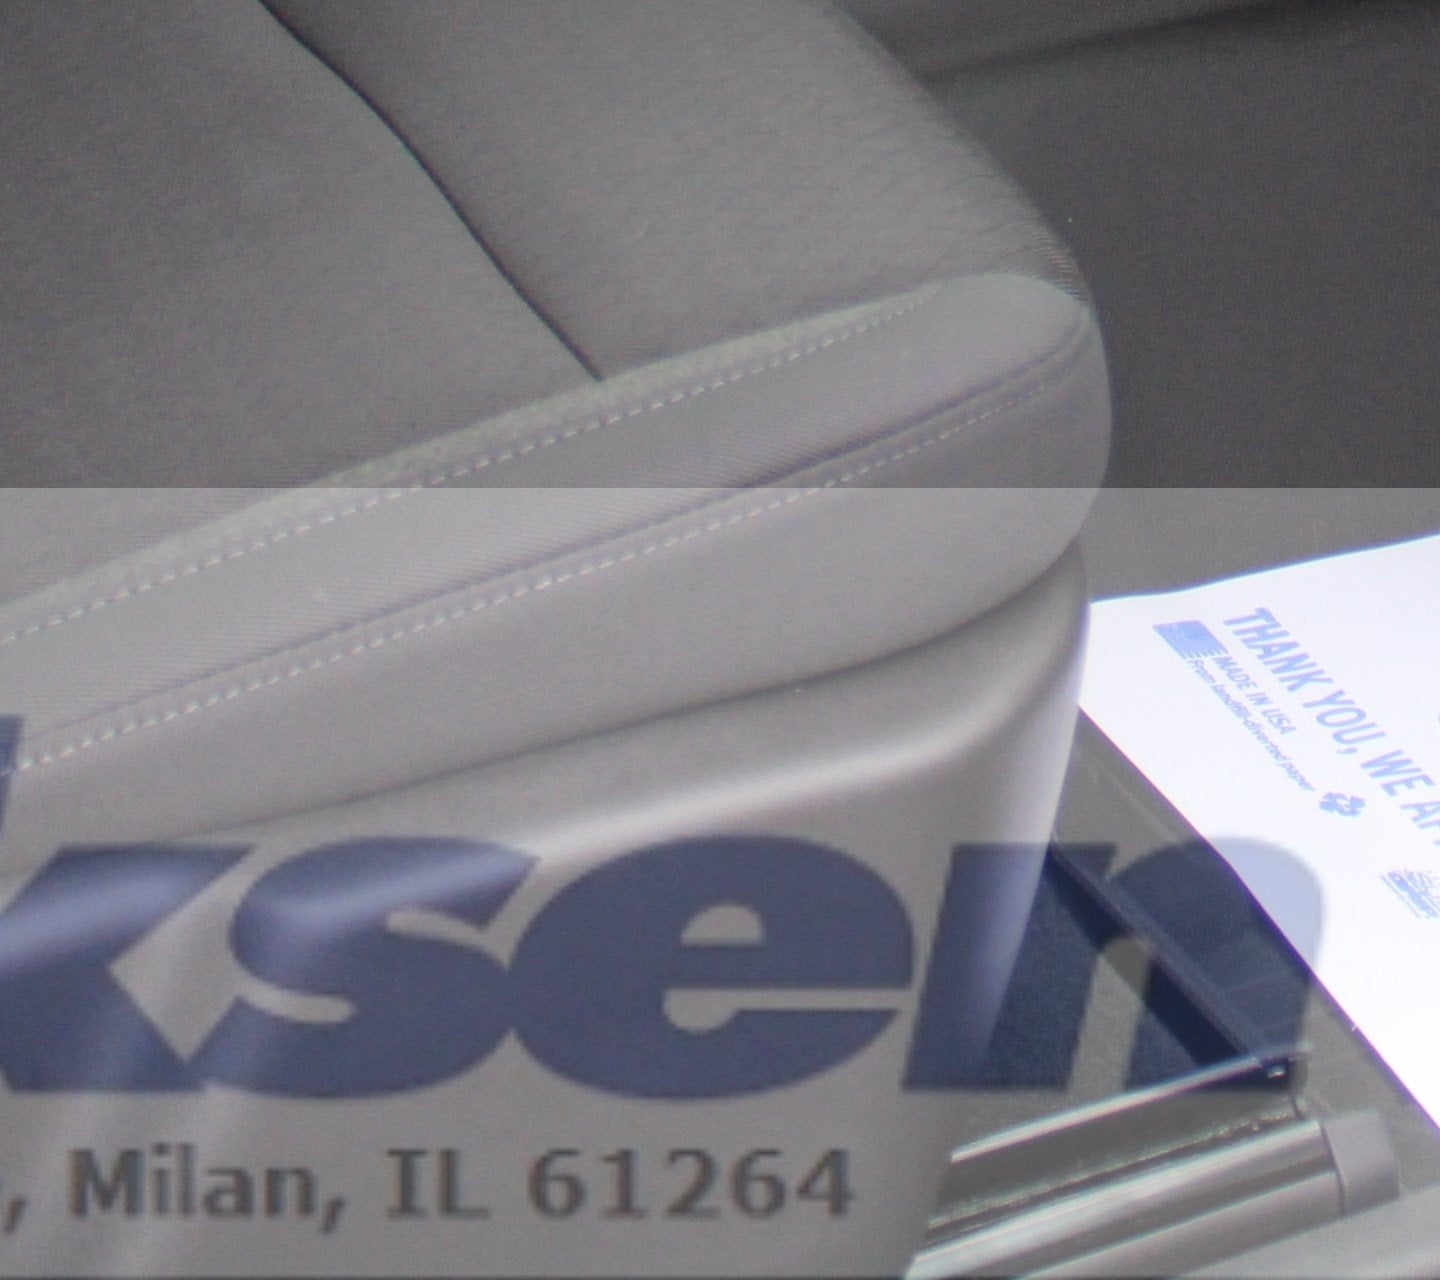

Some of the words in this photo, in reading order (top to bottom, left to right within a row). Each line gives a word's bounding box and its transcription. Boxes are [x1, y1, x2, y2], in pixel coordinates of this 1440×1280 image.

[1212, 656, 1258, 690] MADE
[1245, 692, 1273, 706] IN
[1261, 708, 1298, 735] USA
[1223, 607, 1334, 693] THANK
[1302, 689, 1387, 755] YOU,
[1360, 749, 1436, 797] WE
